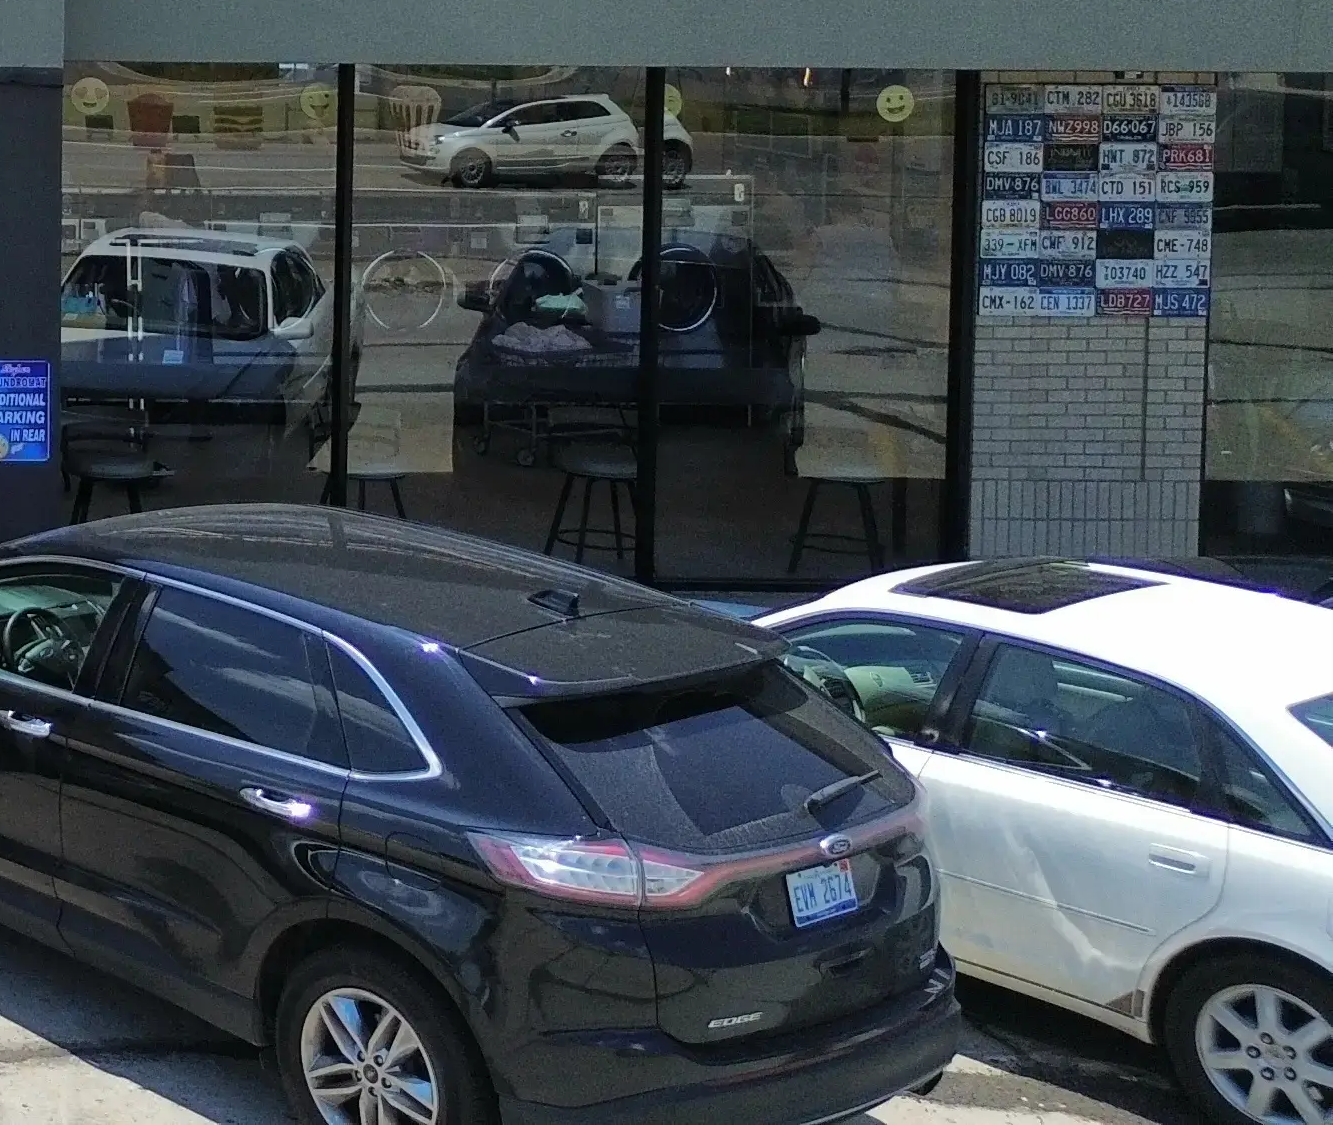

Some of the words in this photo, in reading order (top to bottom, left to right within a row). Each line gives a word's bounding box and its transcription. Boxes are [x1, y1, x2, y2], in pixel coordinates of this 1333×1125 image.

[1077, 91, 1100, 105] 282
[989, 120, 1013, 136] MJA
[1018, 120, 1042, 136] 187
[1191, 122, 1214, 136] 156
[987, 151, 1010, 164] CSF
[1018, 151, 1040, 165] 186
[1101, 181, 1124, 195] CTD
[1132, 181, 1152, 195] 151
[1187, 180, 1210, 194] 959
[1101, 208, 1123, 223] LHX
[1128, 208, 1152, 223] 289
[1072, 236, 1095, 250] 912
[1185, 265, 1208, 279] 547
[1181, 294, 1205, 310] 472
[10, 428, 20, 442] IN
[22, 428, 46, 442] REAR
[707, 1011, 763, 1028] EDGE
